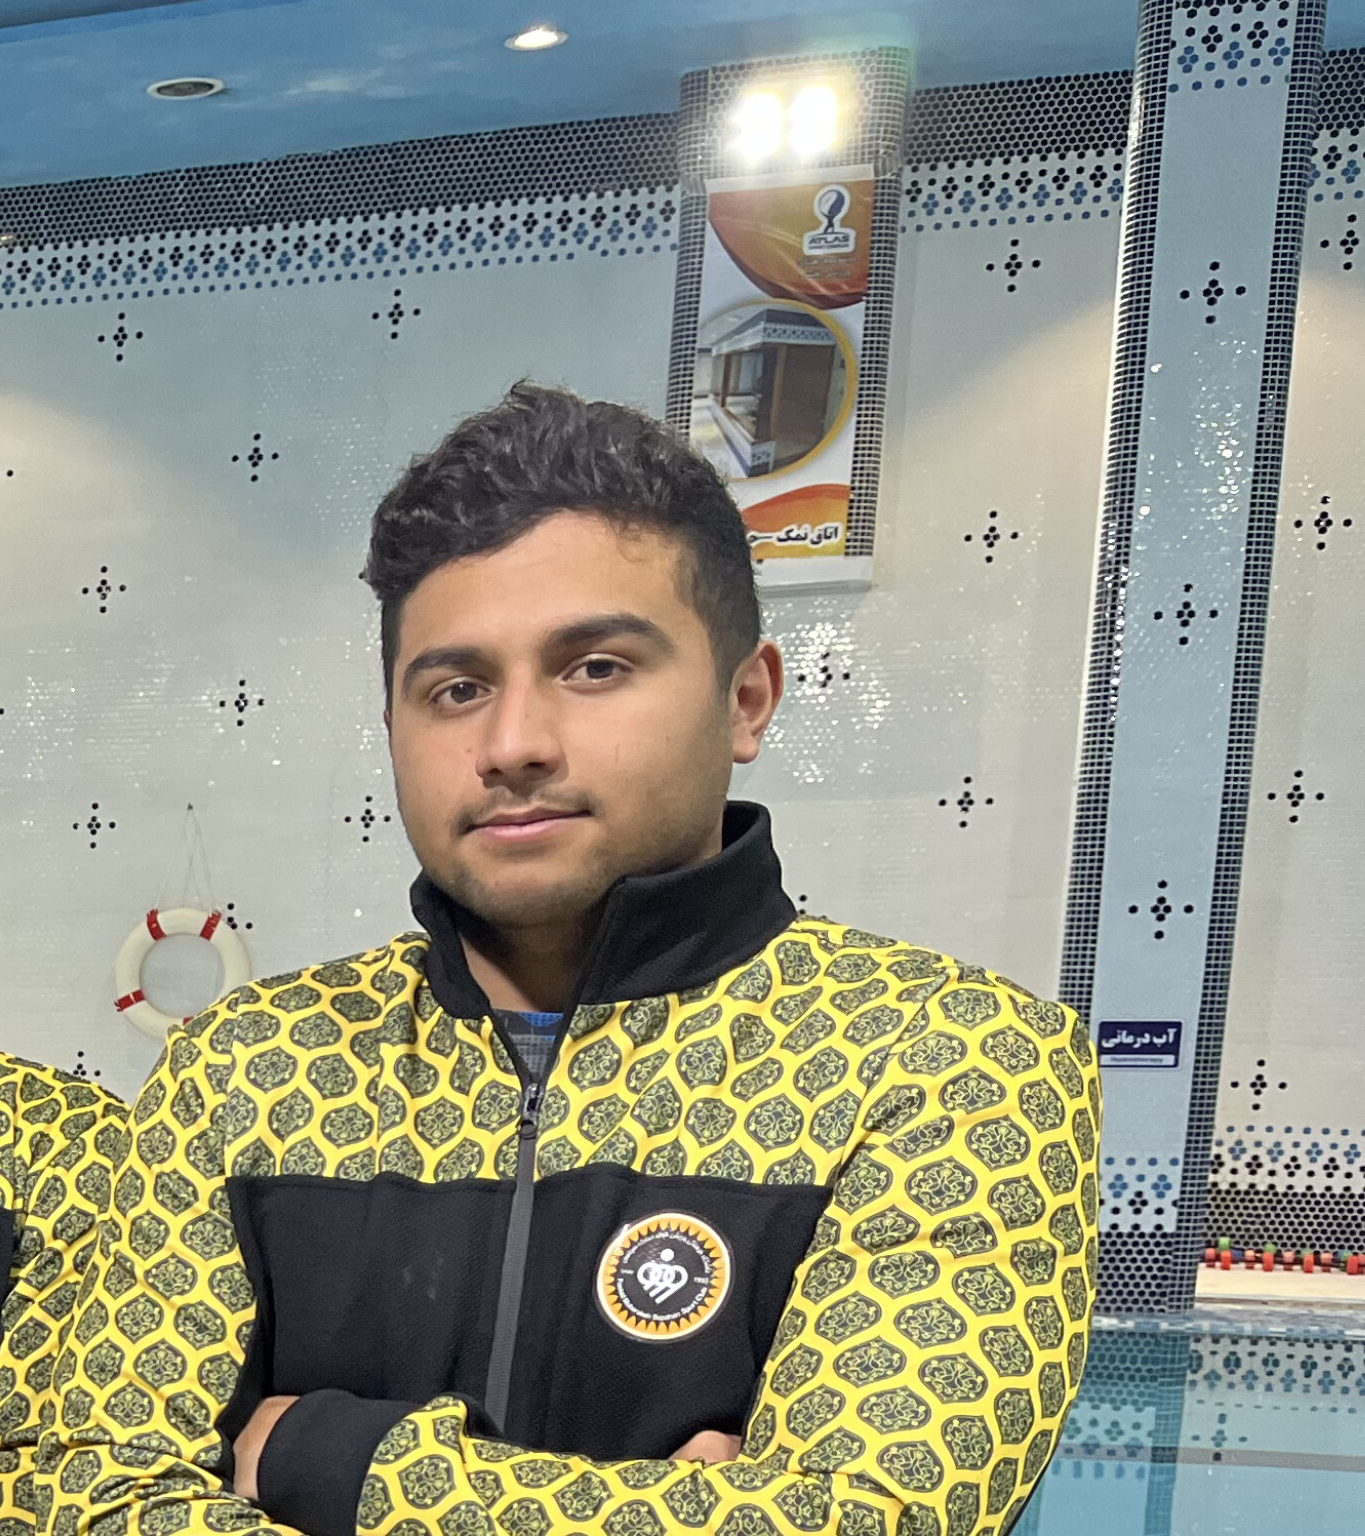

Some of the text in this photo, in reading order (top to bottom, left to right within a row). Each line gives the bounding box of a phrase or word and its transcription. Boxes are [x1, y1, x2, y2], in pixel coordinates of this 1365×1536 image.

[776, 526, 808, 542] نمک
[810, 526, 839, 545] اتاق
[1101, 1027, 1178, 1049] آب درمانی
